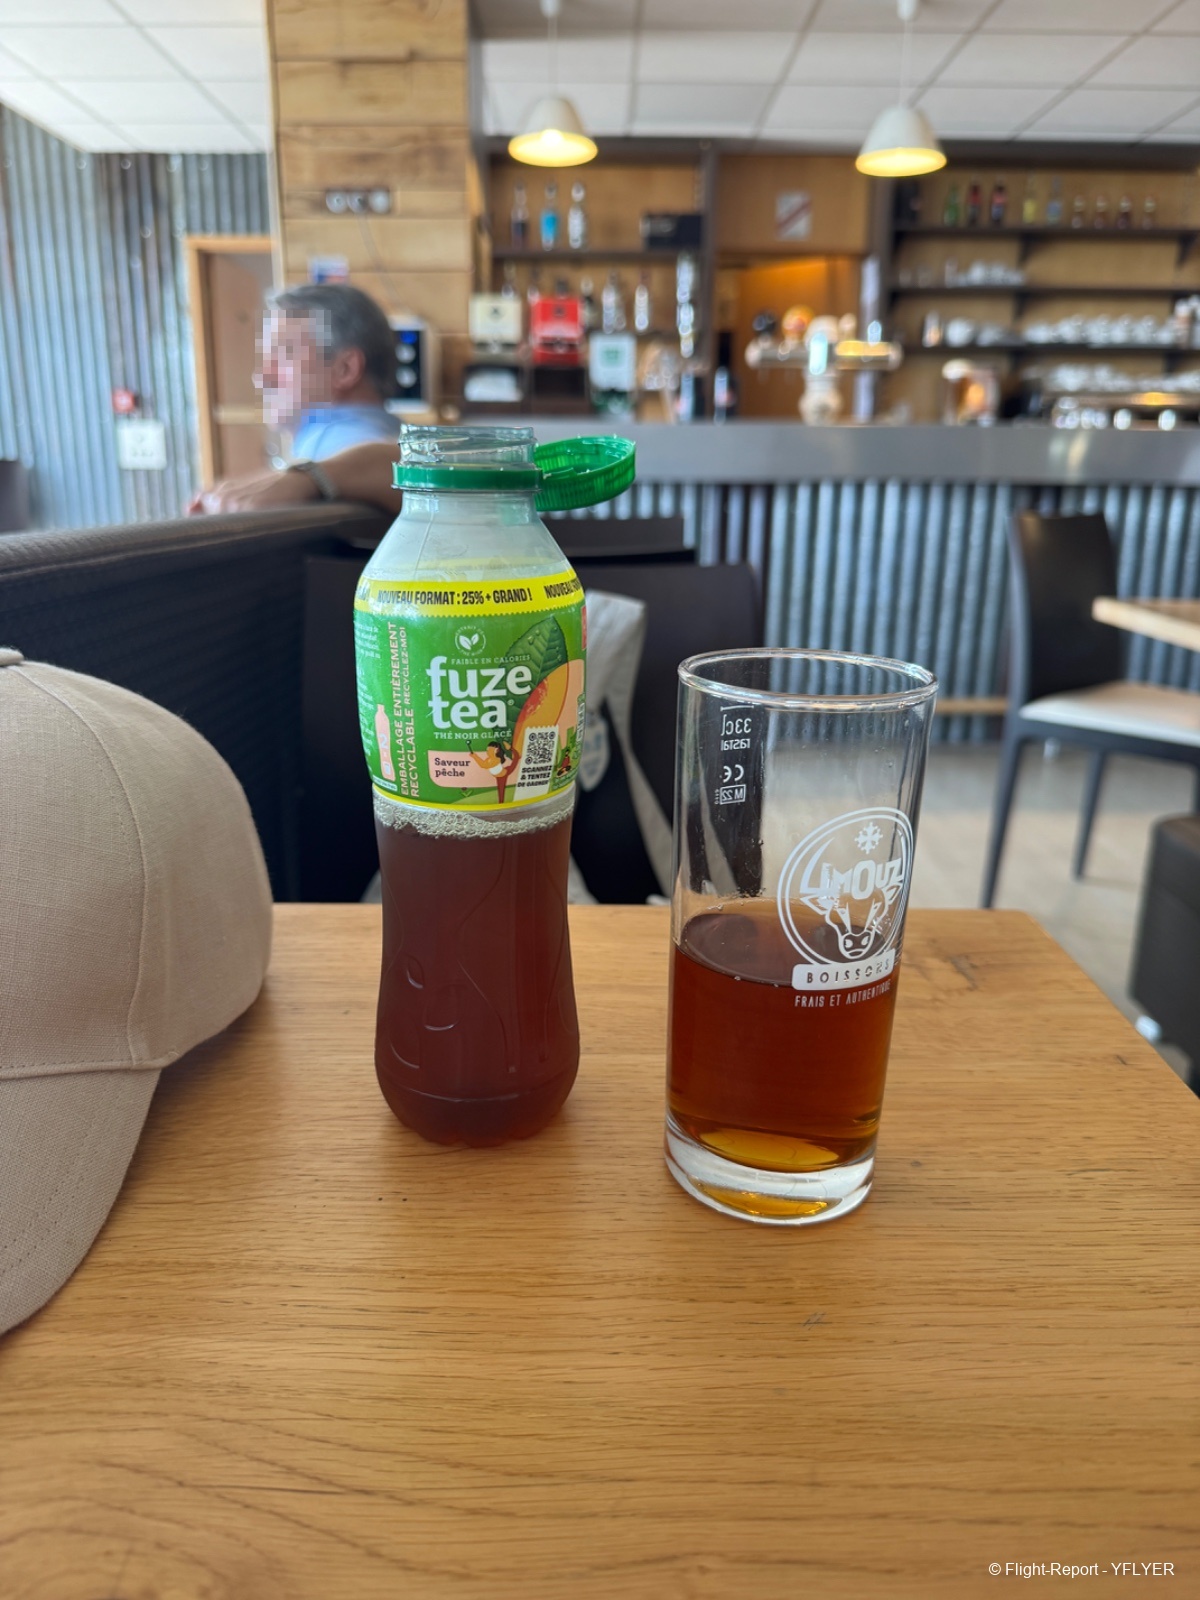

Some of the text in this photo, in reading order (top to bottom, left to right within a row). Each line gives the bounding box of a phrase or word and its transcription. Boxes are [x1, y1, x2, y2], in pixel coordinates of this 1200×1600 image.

[378, 590, 413, 604] NOUVEAU
[415, 591, 455, 605] FORMAT
[462, 591, 484, 605] 25%
[485, 593, 491, 601] +
[493, 588, 527, 603] GRAND
[493, 654, 530, 664] CALORIES
[425, 655, 532, 698] fuze
[388, 621, 409, 795] EMBALLAGE ENTIÈREMENT
[399, 627, 419, 797] RECYCLABLE RECYCLEZ-MOI
[428, 696, 507, 729] tea
[434, 730, 512, 740] THÉ NOIR GLACÉ
[434, 757, 470, 767] Saveur
[521, 765, 552, 773] SCANNEZ
[435, 767, 465, 777] pêche
[527, 772, 550, 780] TENTEZ
[806, 958, 890, 984] BOISSONS
[794, 995, 825, 1008] FRAIS
[829, 994, 841, 1006] ET
